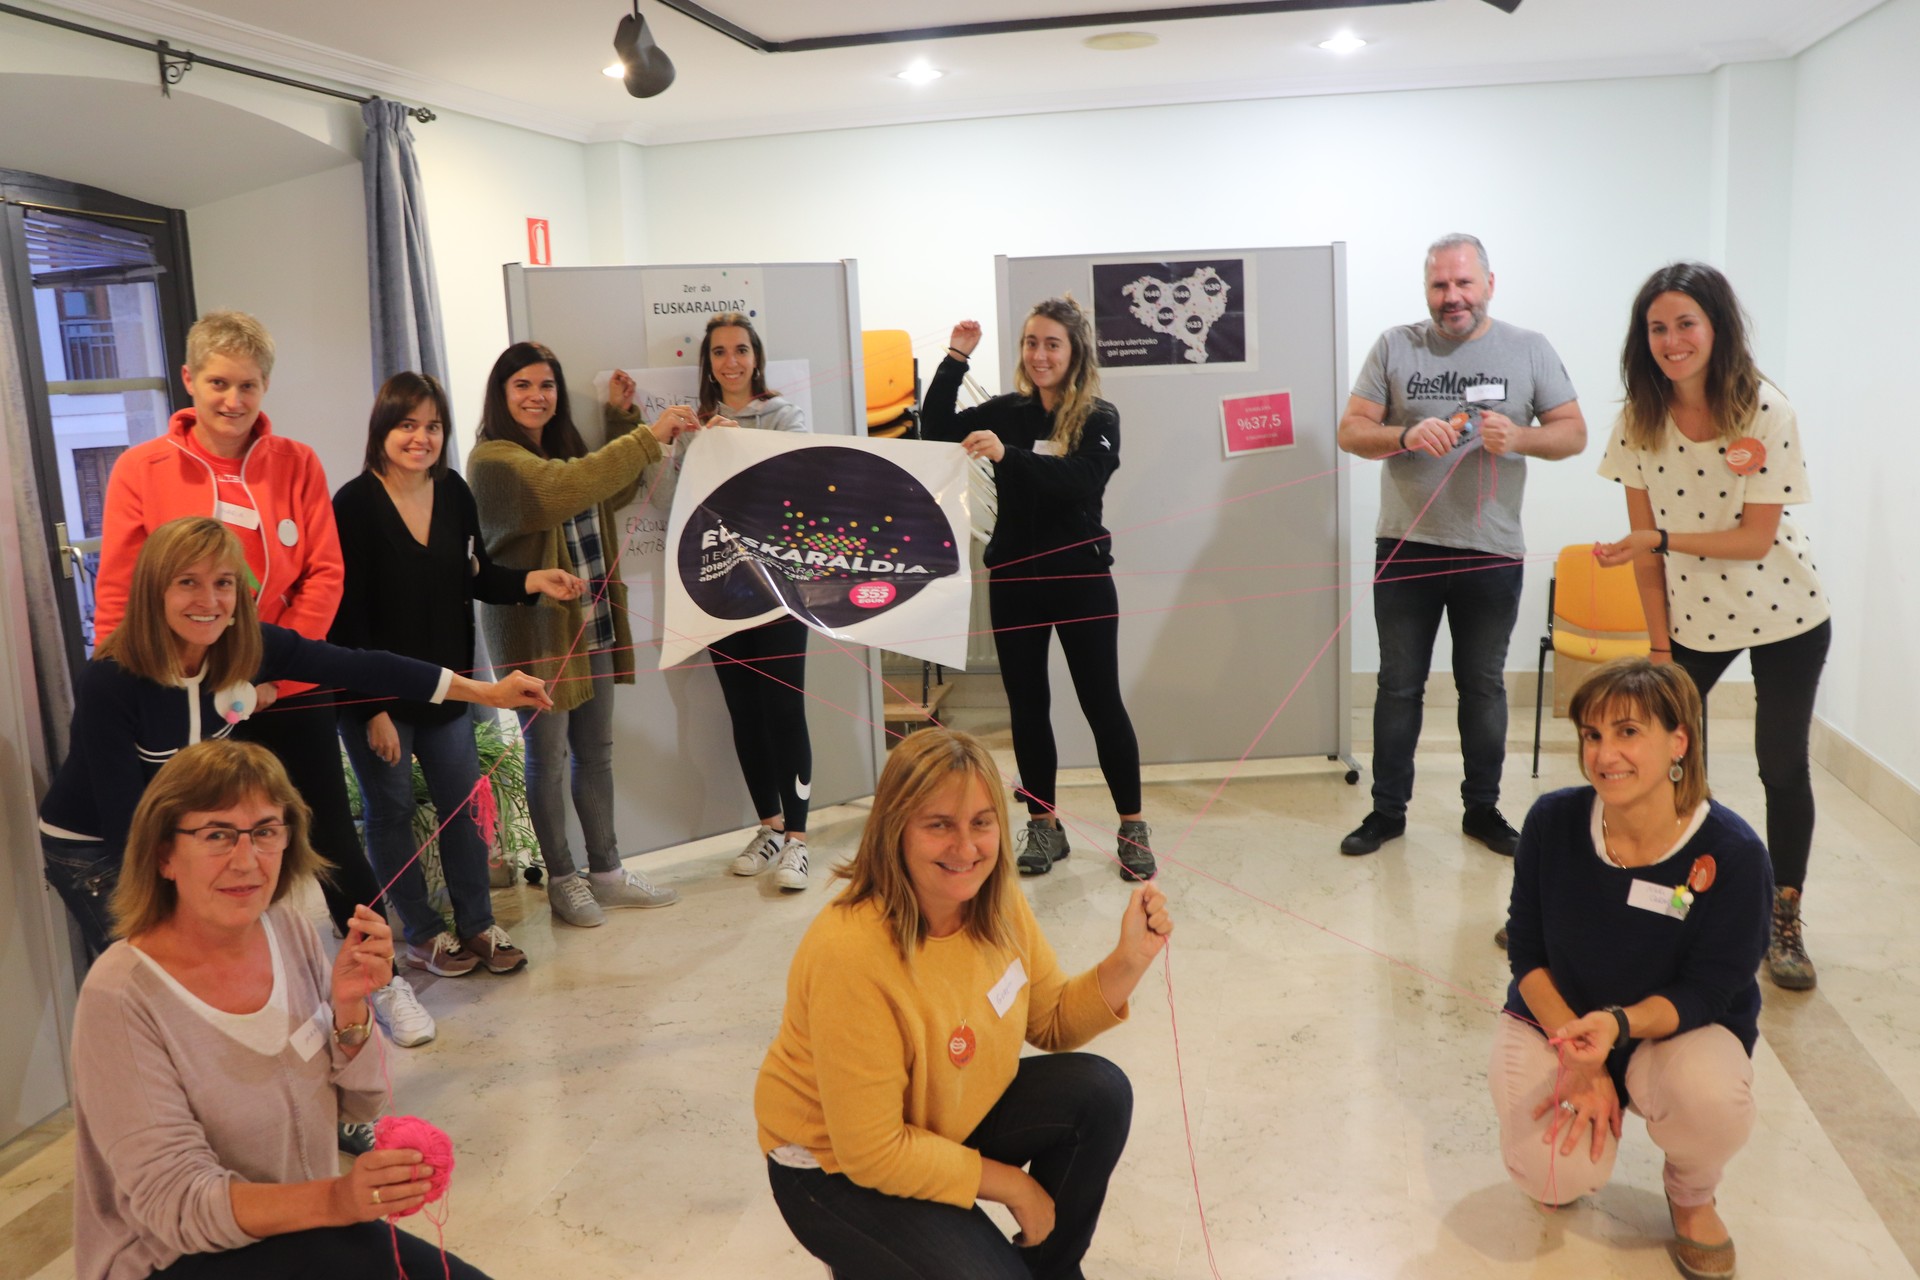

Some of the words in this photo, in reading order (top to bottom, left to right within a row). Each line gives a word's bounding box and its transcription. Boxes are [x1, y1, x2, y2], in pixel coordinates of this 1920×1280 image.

[701, 284, 712, 293] da
[653, 299, 746, 315] EUSKARALDIA?
[1237, 413, 1282, 432] %37,5
[701, 526, 931, 574] EUSKARALDIA
